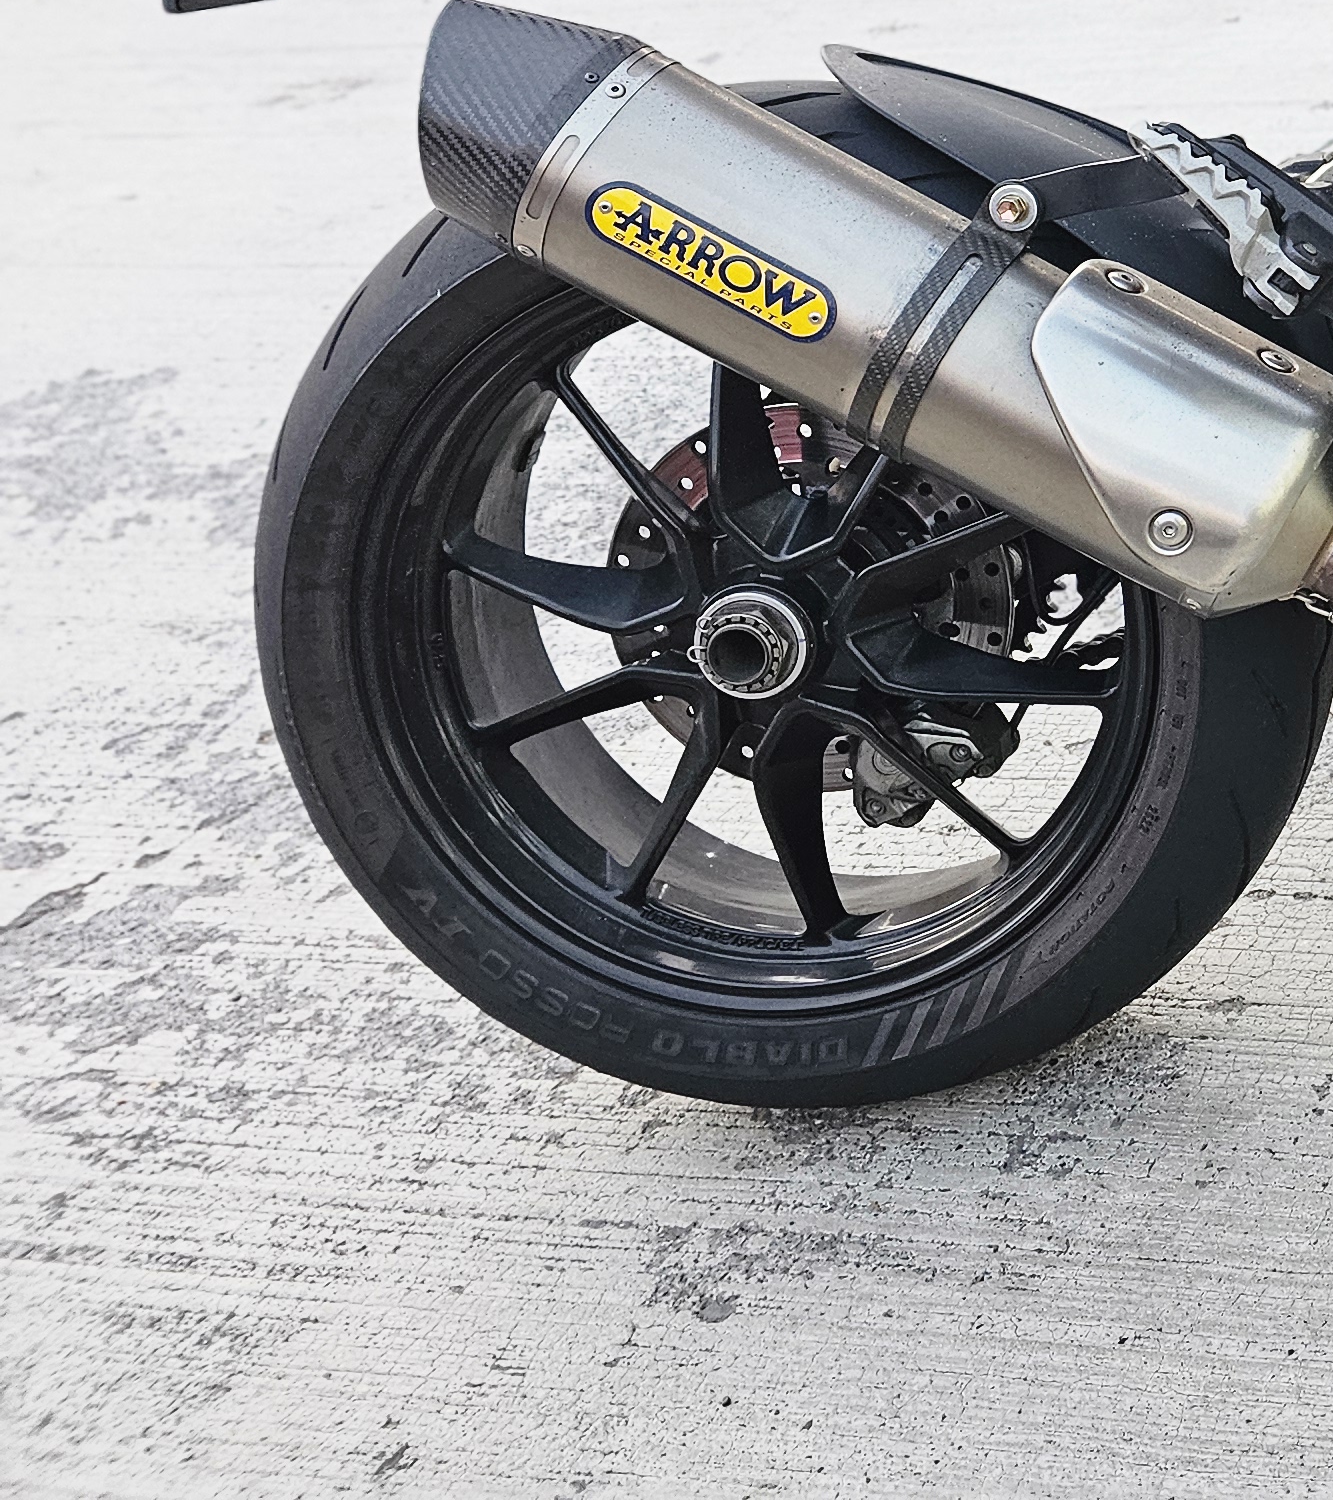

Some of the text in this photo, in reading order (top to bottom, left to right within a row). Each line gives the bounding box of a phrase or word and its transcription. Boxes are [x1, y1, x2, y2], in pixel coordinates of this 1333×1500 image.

[612, 200, 818, 317] ARROW
[612, 231, 793, 331] SPECIAL PARTS
[1048, 878, 1117, 956] ROTATION
[478, 947, 632, 1046] ROSSO
[650, 1027, 850, 1067] DIABLO
